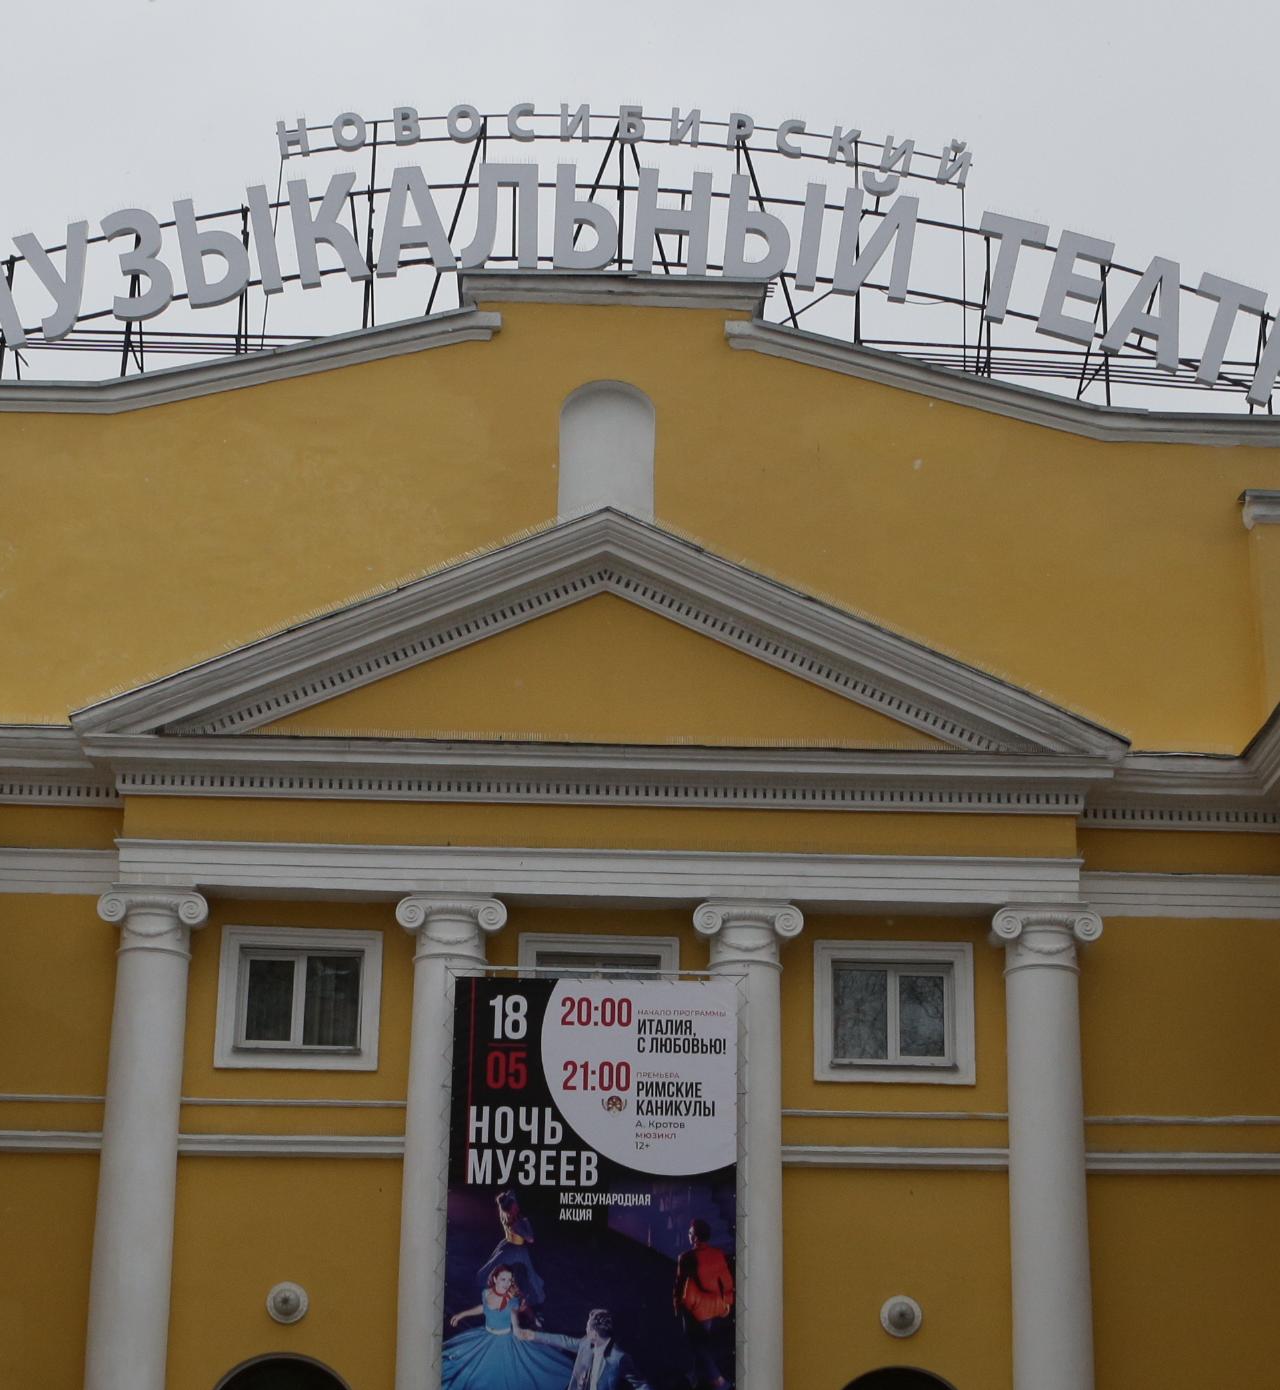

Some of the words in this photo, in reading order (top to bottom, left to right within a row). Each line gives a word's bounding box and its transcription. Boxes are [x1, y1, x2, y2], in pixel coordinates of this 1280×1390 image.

[277, 102, 973, 188] НОВОСИБИРСКИЙ
[489, 994, 528, 1040] 18
[560, 996, 632, 1027] 20:00
[637, 1019, 696, 1037] ИТАЛИЯ,
[637, 1037, 645, 1053] С
[649, 1037, 726, 1055] ЛЮБОВЬЮ!
[486, 1051, 528, 1089] 05
[562, 1060, 631, 1092] 21:00
[636, 1081, 702, 1098] РИМСКИЕ
[636, 1100, 715, 1117] КАНИКУЛЫ
[469, 1105, 563, 1144] НОЧЬ
[648, 1120, 685, 1130] Кротов
[635, 1142, 650, 1150] 12+
[467, 1149, 598, 1186] МУЗЕЕВ
[560, 1192, 651, 1206] МЕЖДУНАРОДНАЯ
[559, 1208, 592, 1221] АКЦИЯ
